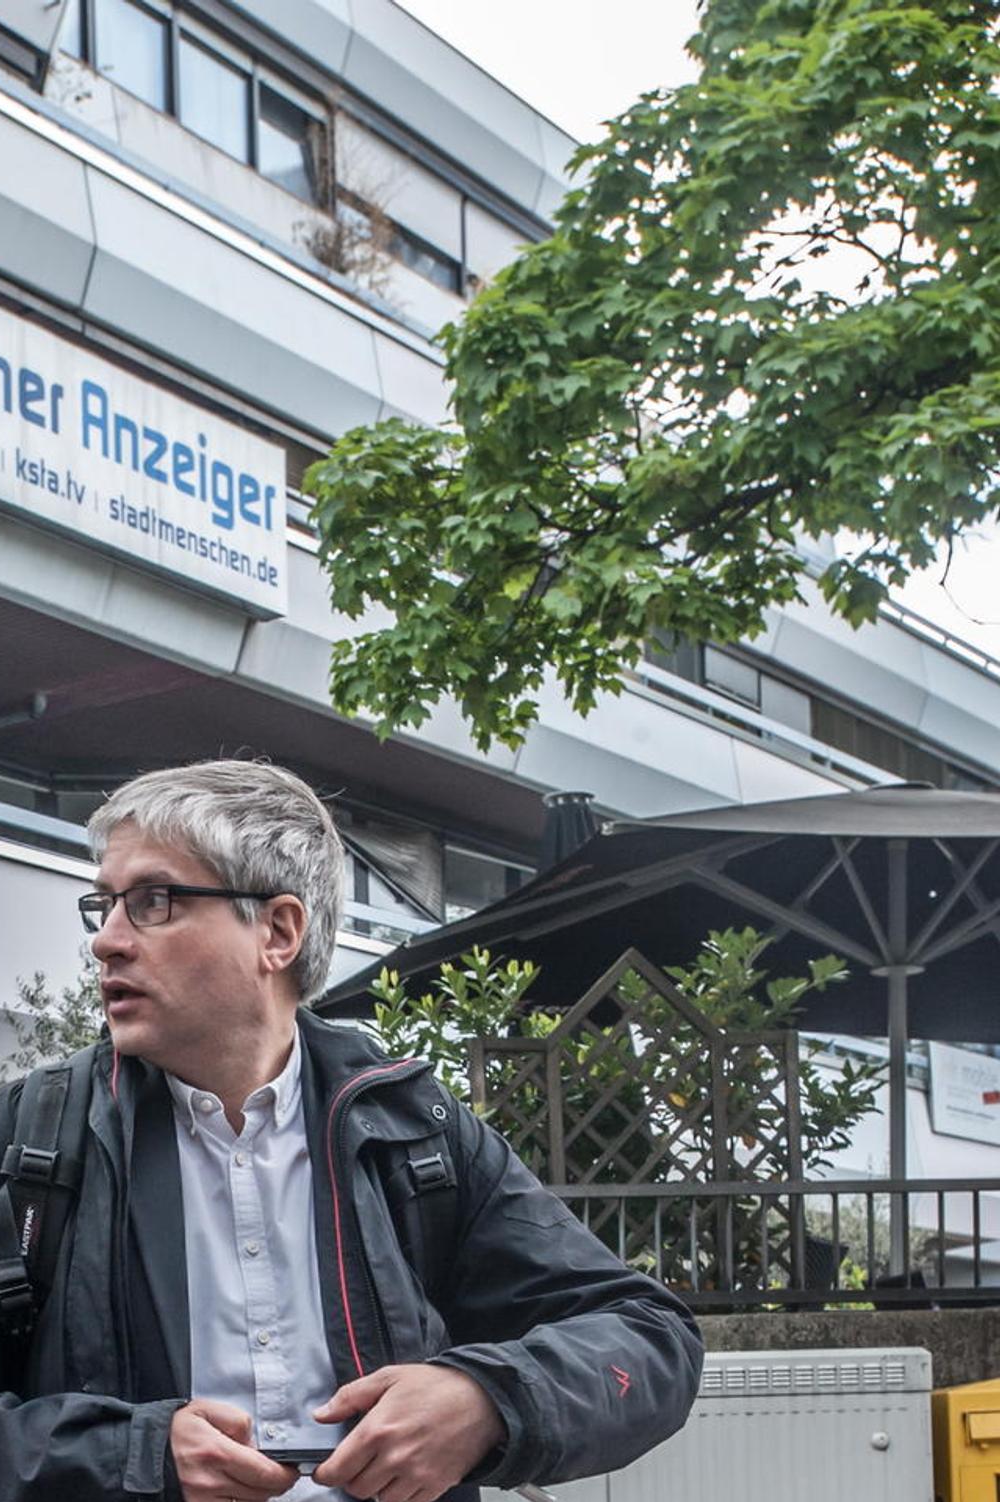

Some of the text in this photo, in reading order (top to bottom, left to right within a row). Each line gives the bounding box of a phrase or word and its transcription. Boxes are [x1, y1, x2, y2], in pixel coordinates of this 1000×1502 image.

[16, 447, 86, 504] ksta.tv
[109, 494, 279, 588] stadtmenschen.de
[81, 379, 276, 531] Anzeiger
